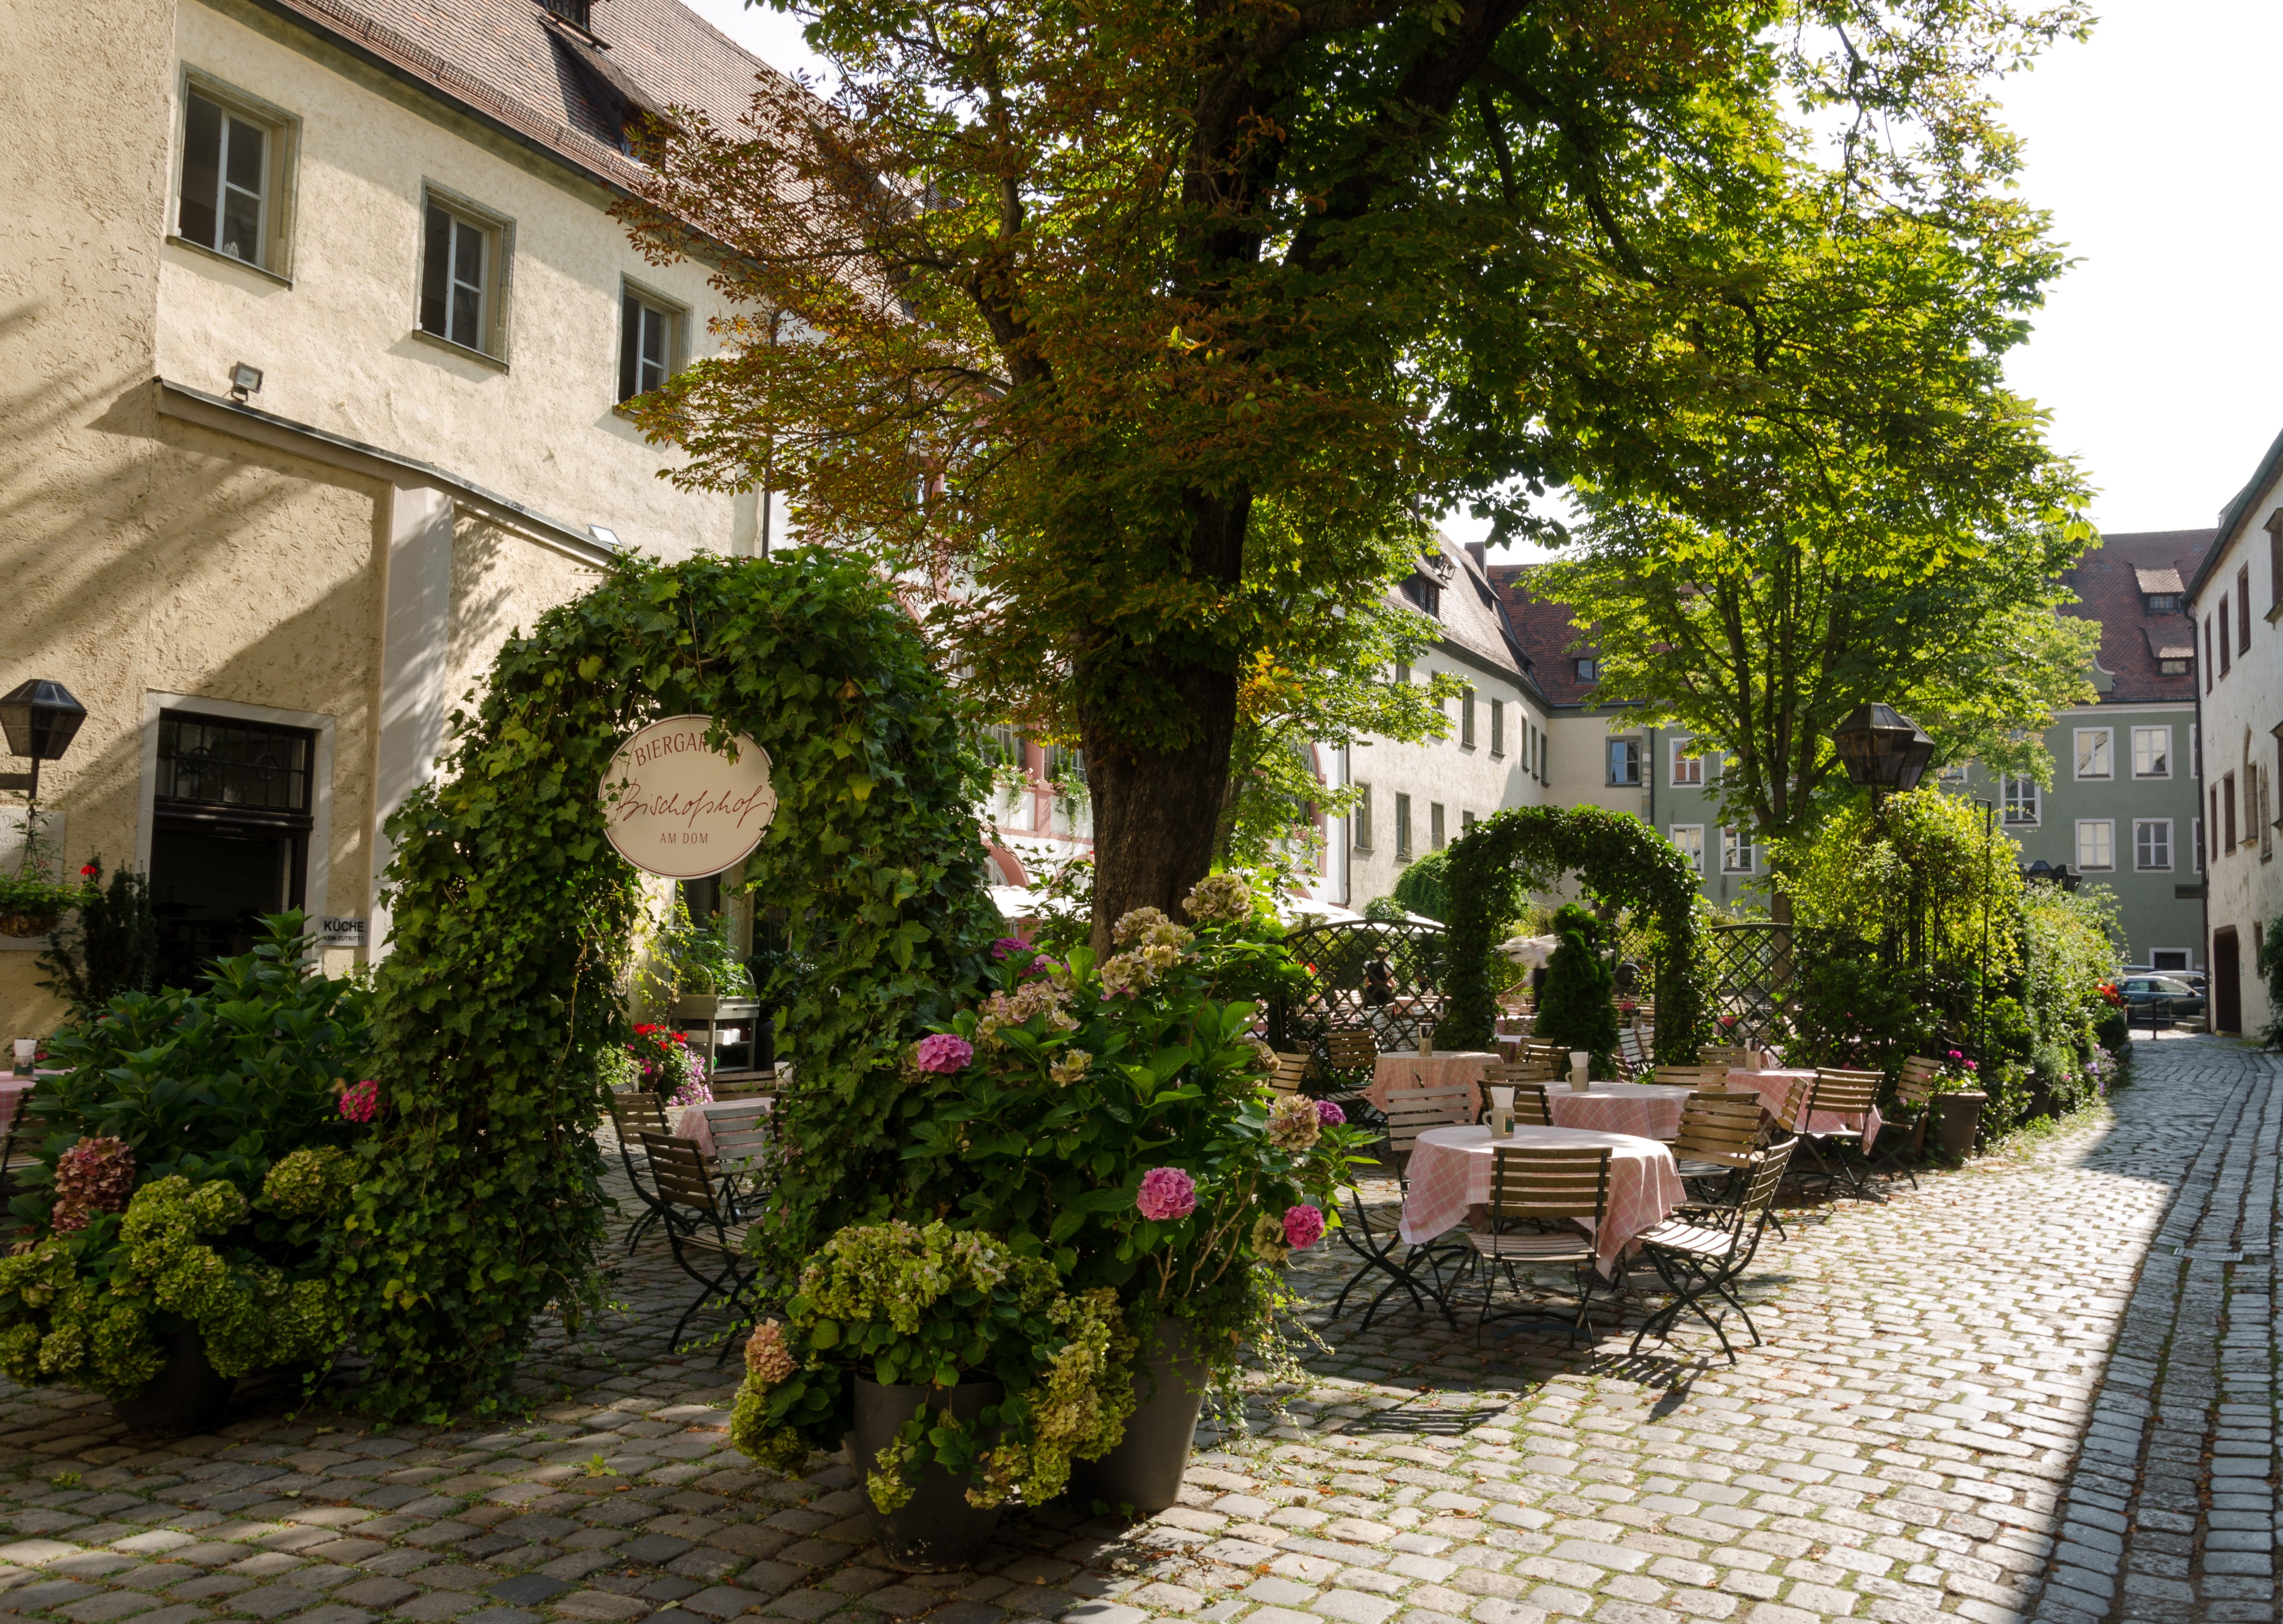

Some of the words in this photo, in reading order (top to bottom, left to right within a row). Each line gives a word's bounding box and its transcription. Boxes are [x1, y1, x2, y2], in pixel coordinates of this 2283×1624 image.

[634, 732, 744, 767] BIERGAREN
[606, 778, 769, 828] Bischofshof
[660, 833, 676, 844] AM
[683, 833, 708, 844] DOM
[323, 918, 364, 932] KÜCHE
